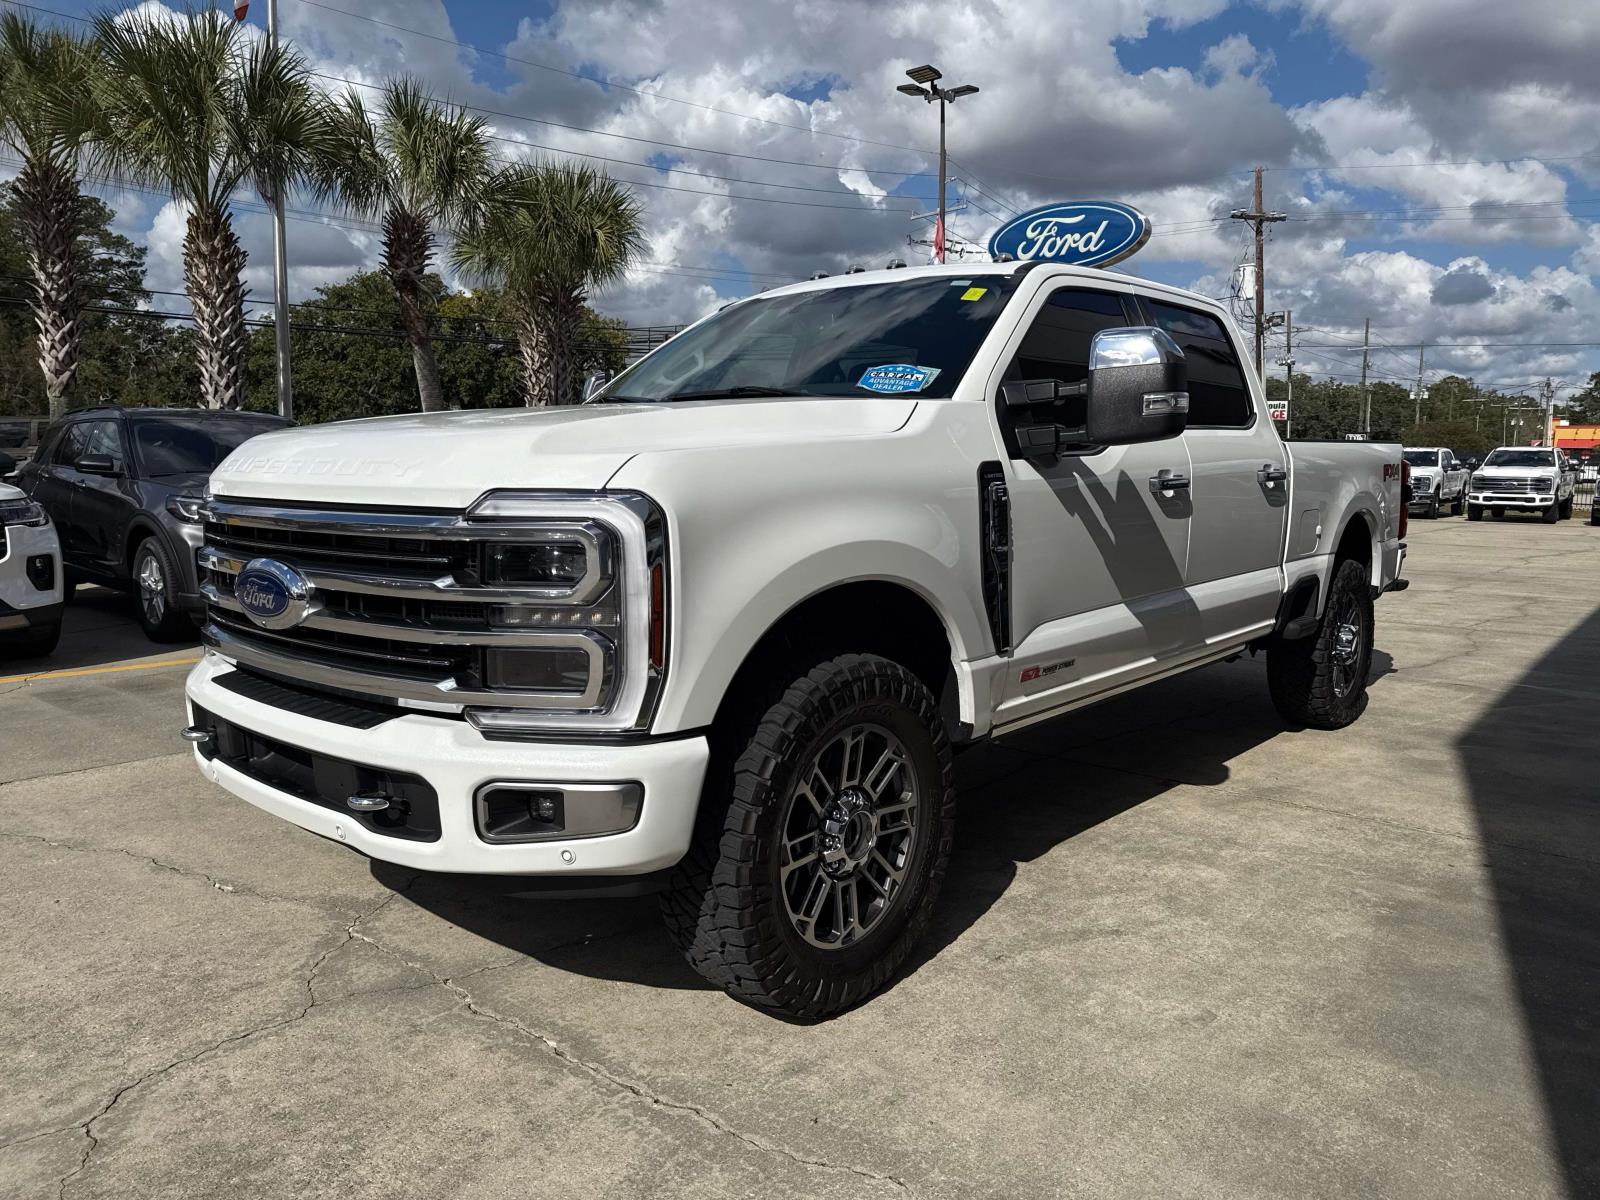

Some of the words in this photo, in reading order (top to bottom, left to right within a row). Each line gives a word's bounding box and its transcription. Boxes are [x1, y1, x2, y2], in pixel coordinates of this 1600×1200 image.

[1017, 214, 1109, 261] Ford
[868, 378, 915, 387] ADVANTAGE
[221, 456, 303, 474] SUPER
[306, 456, 424, 478] DUTY
[243, 577, 275, 609] Ford
